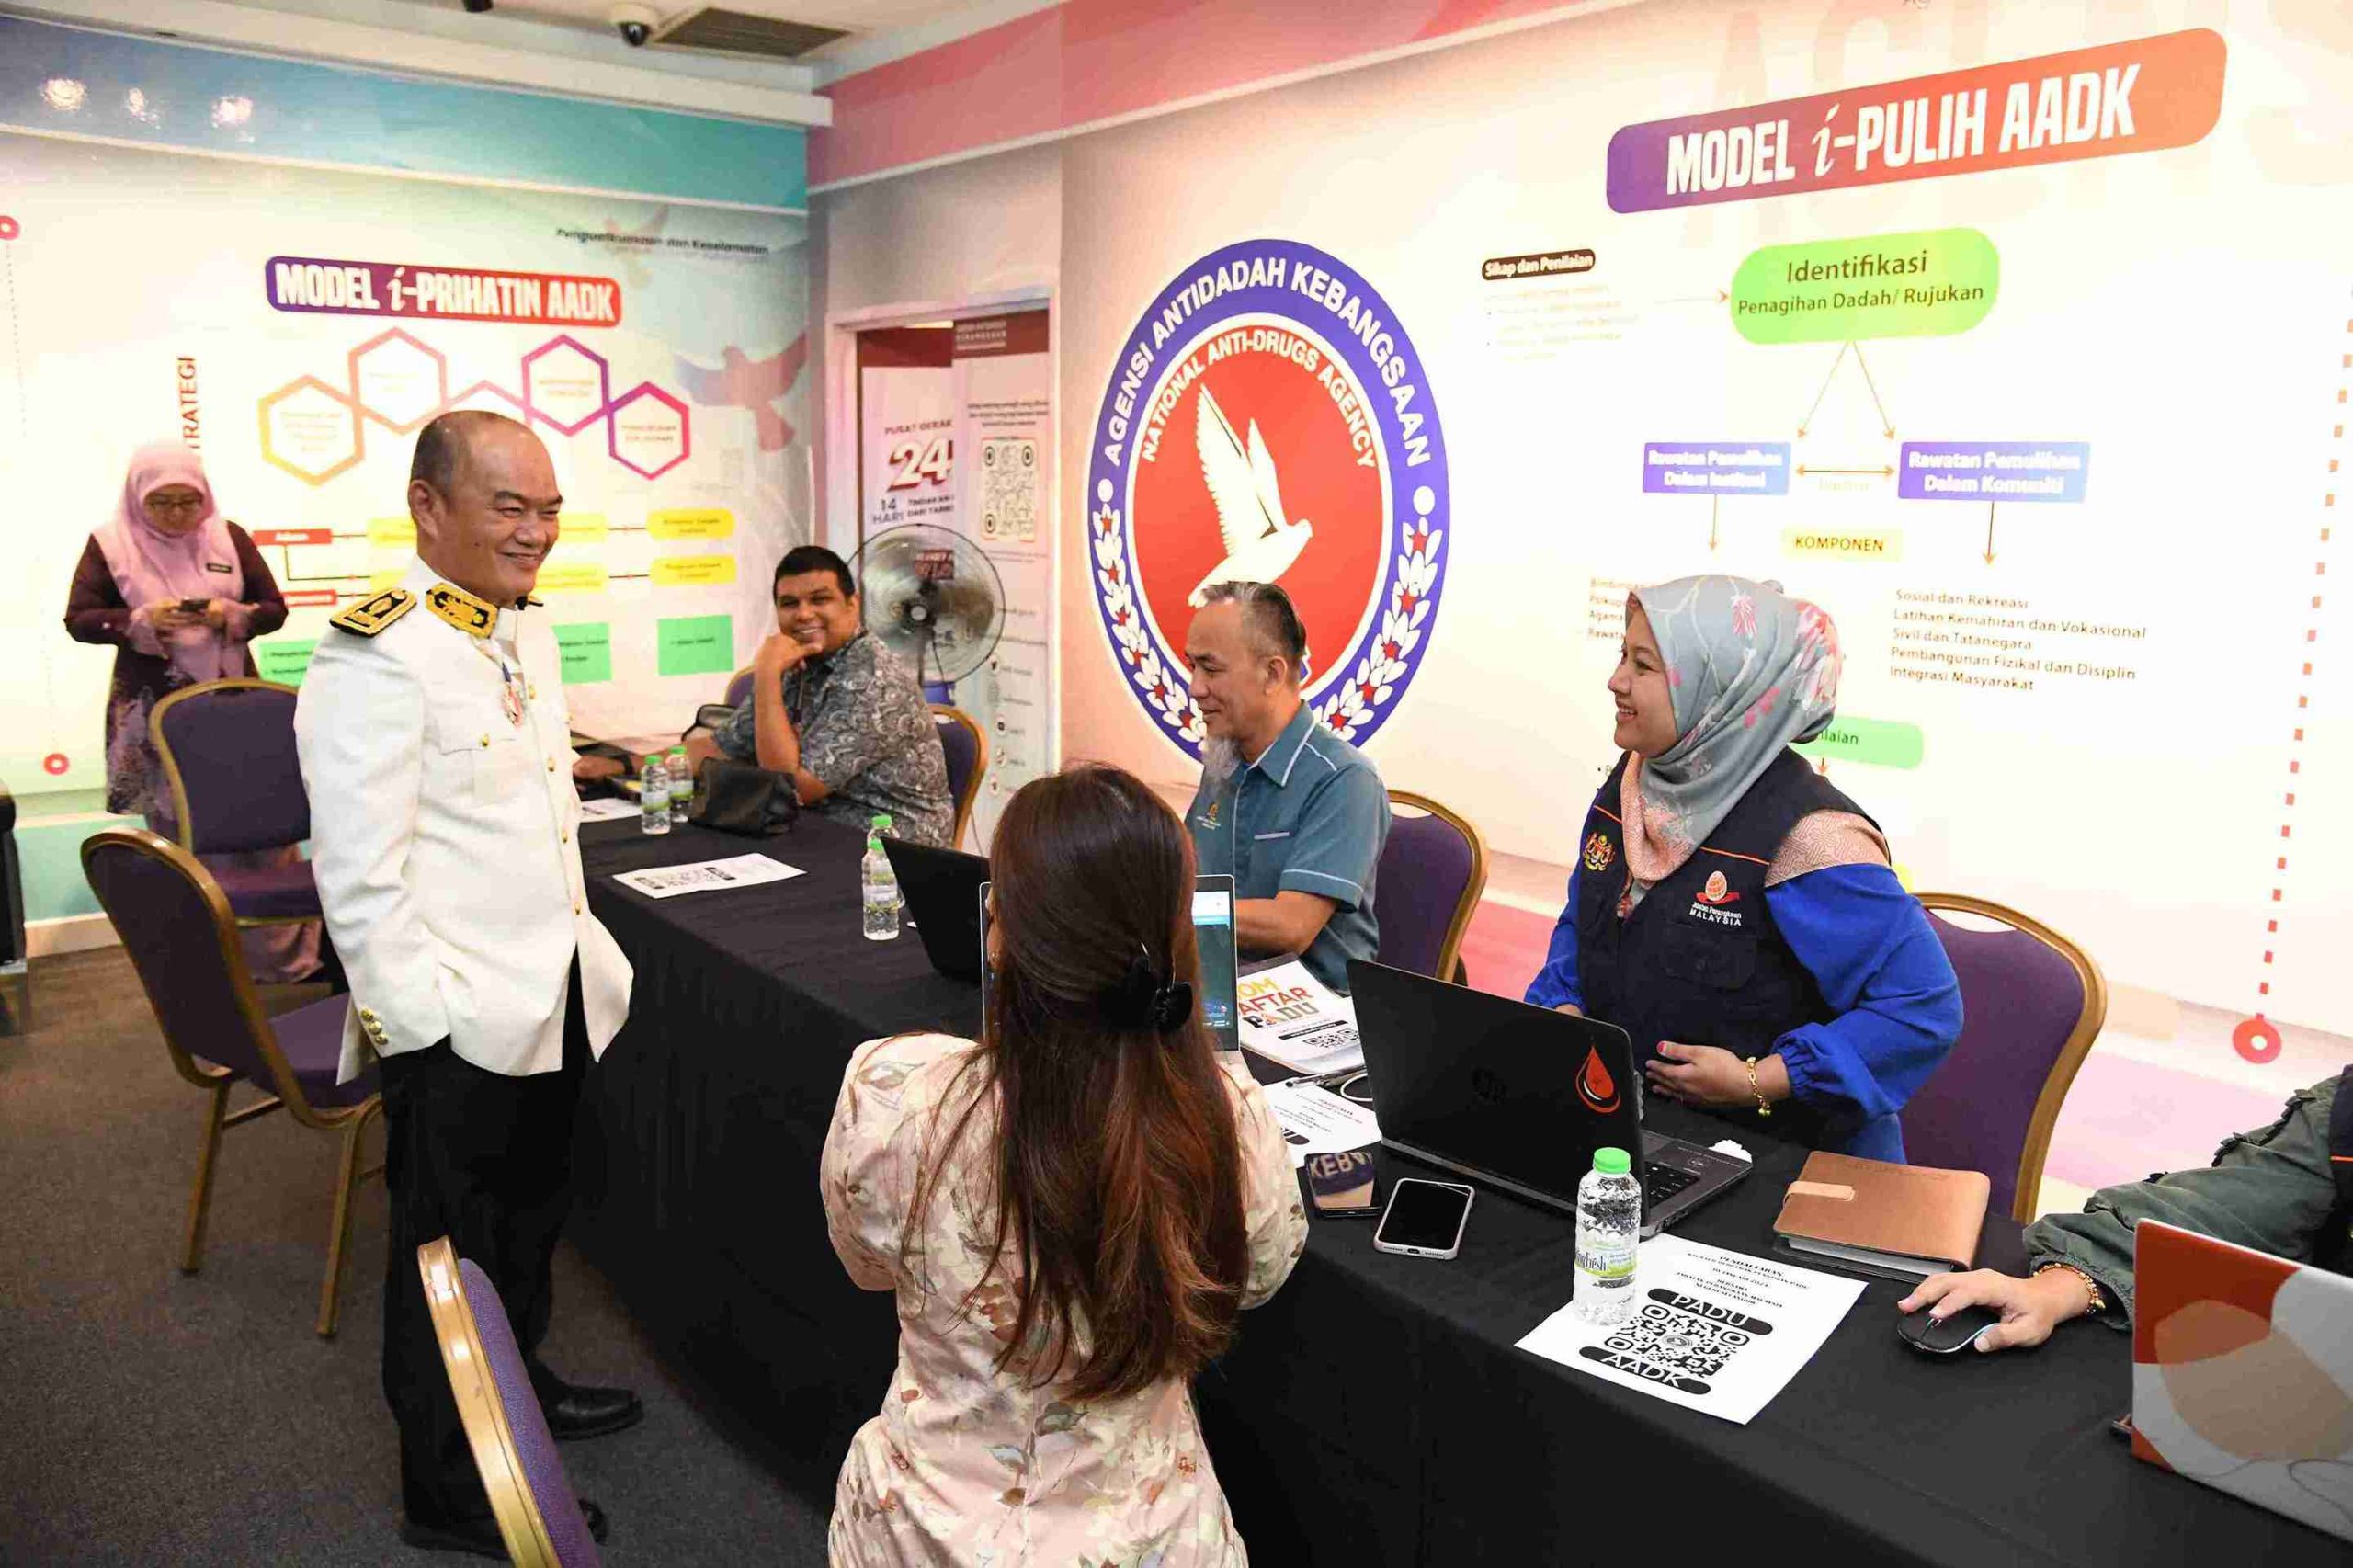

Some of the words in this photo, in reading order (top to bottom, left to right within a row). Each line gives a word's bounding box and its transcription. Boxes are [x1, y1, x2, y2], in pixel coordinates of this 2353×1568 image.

[1666, 119, 1795, 195] MODEL
[1812, 103, 1987, 177] i-PULIH
[1999, 63, 2142, 152] AADK
[1787, 250, 1928, 283] Identifikasi
[276, 263, 380, 311] MODEL
[386, 266, 543, 317] i-PRIHATIN
[547, 280, 615, 321] AADK
[1738, 294, 1828, 316] Penagihan
[1904, 284, 1984, 307] Rujukan
[1103, 342, 1155, 467] AGENSI
[1151, 256, 1287, 349] ANTIDADAH
[1290, 261, 1431, 467] KEBANGSAAN
[1142, 356, 1206, 462] NATIONAL
[1207, 329, 1321, 372] ANTI-DRUGS
[1318, 367, 1376, 469] AGENCY
[920, 419, 952, 431] GERAK
[1908, 450, 1981, 470] Rawatan
[1984, 450, 2080, 471] Pemulihan
[1924, 474, 1978, 493] Dalam
[1981, 475, 2066, 494] Komuniti
[1794, 535, 1884, 553] KOMPONEN
[1895, 589, 1935, 602] Sosial
[1938, 592, 1963, 605] dan
[1968, 595, 2029, 609] Rekreasi
[1893, 608, 1943, 622] Latihan
[1948, 613, 2025, 629] Kemahiran
[2029, 619, 2057, 632] dan
[2061, 621, 2146, 640] Vokasional
[1893, 628, 1920, 641] Sivil
[1923, 631, 1949, 642] dan
[1954, 632, 2031, 651] Tatanegara
[1891, 646, 1990, 666] Pembangunan
[1994, 654, 2040, 671] Fizikal
[2044, 660, 2072, 674] dan
[2077, 663, 2136, 680] Disiplin
[1890, 665, 1948, 682] Integrasi
[1952, 671, 2034, 691] Masyarakat
[1689, 908, 1742, 926] MALAYSIA
[1238, 976, 1280, 996] OM
[1238, 987, 1313, 1015] AFTAR
[1243, 1002, 1320, 1028] PADU
[1670, 1292, 1747, 1326] PADU
[1601, 1351, 1683, 1387] AADK
